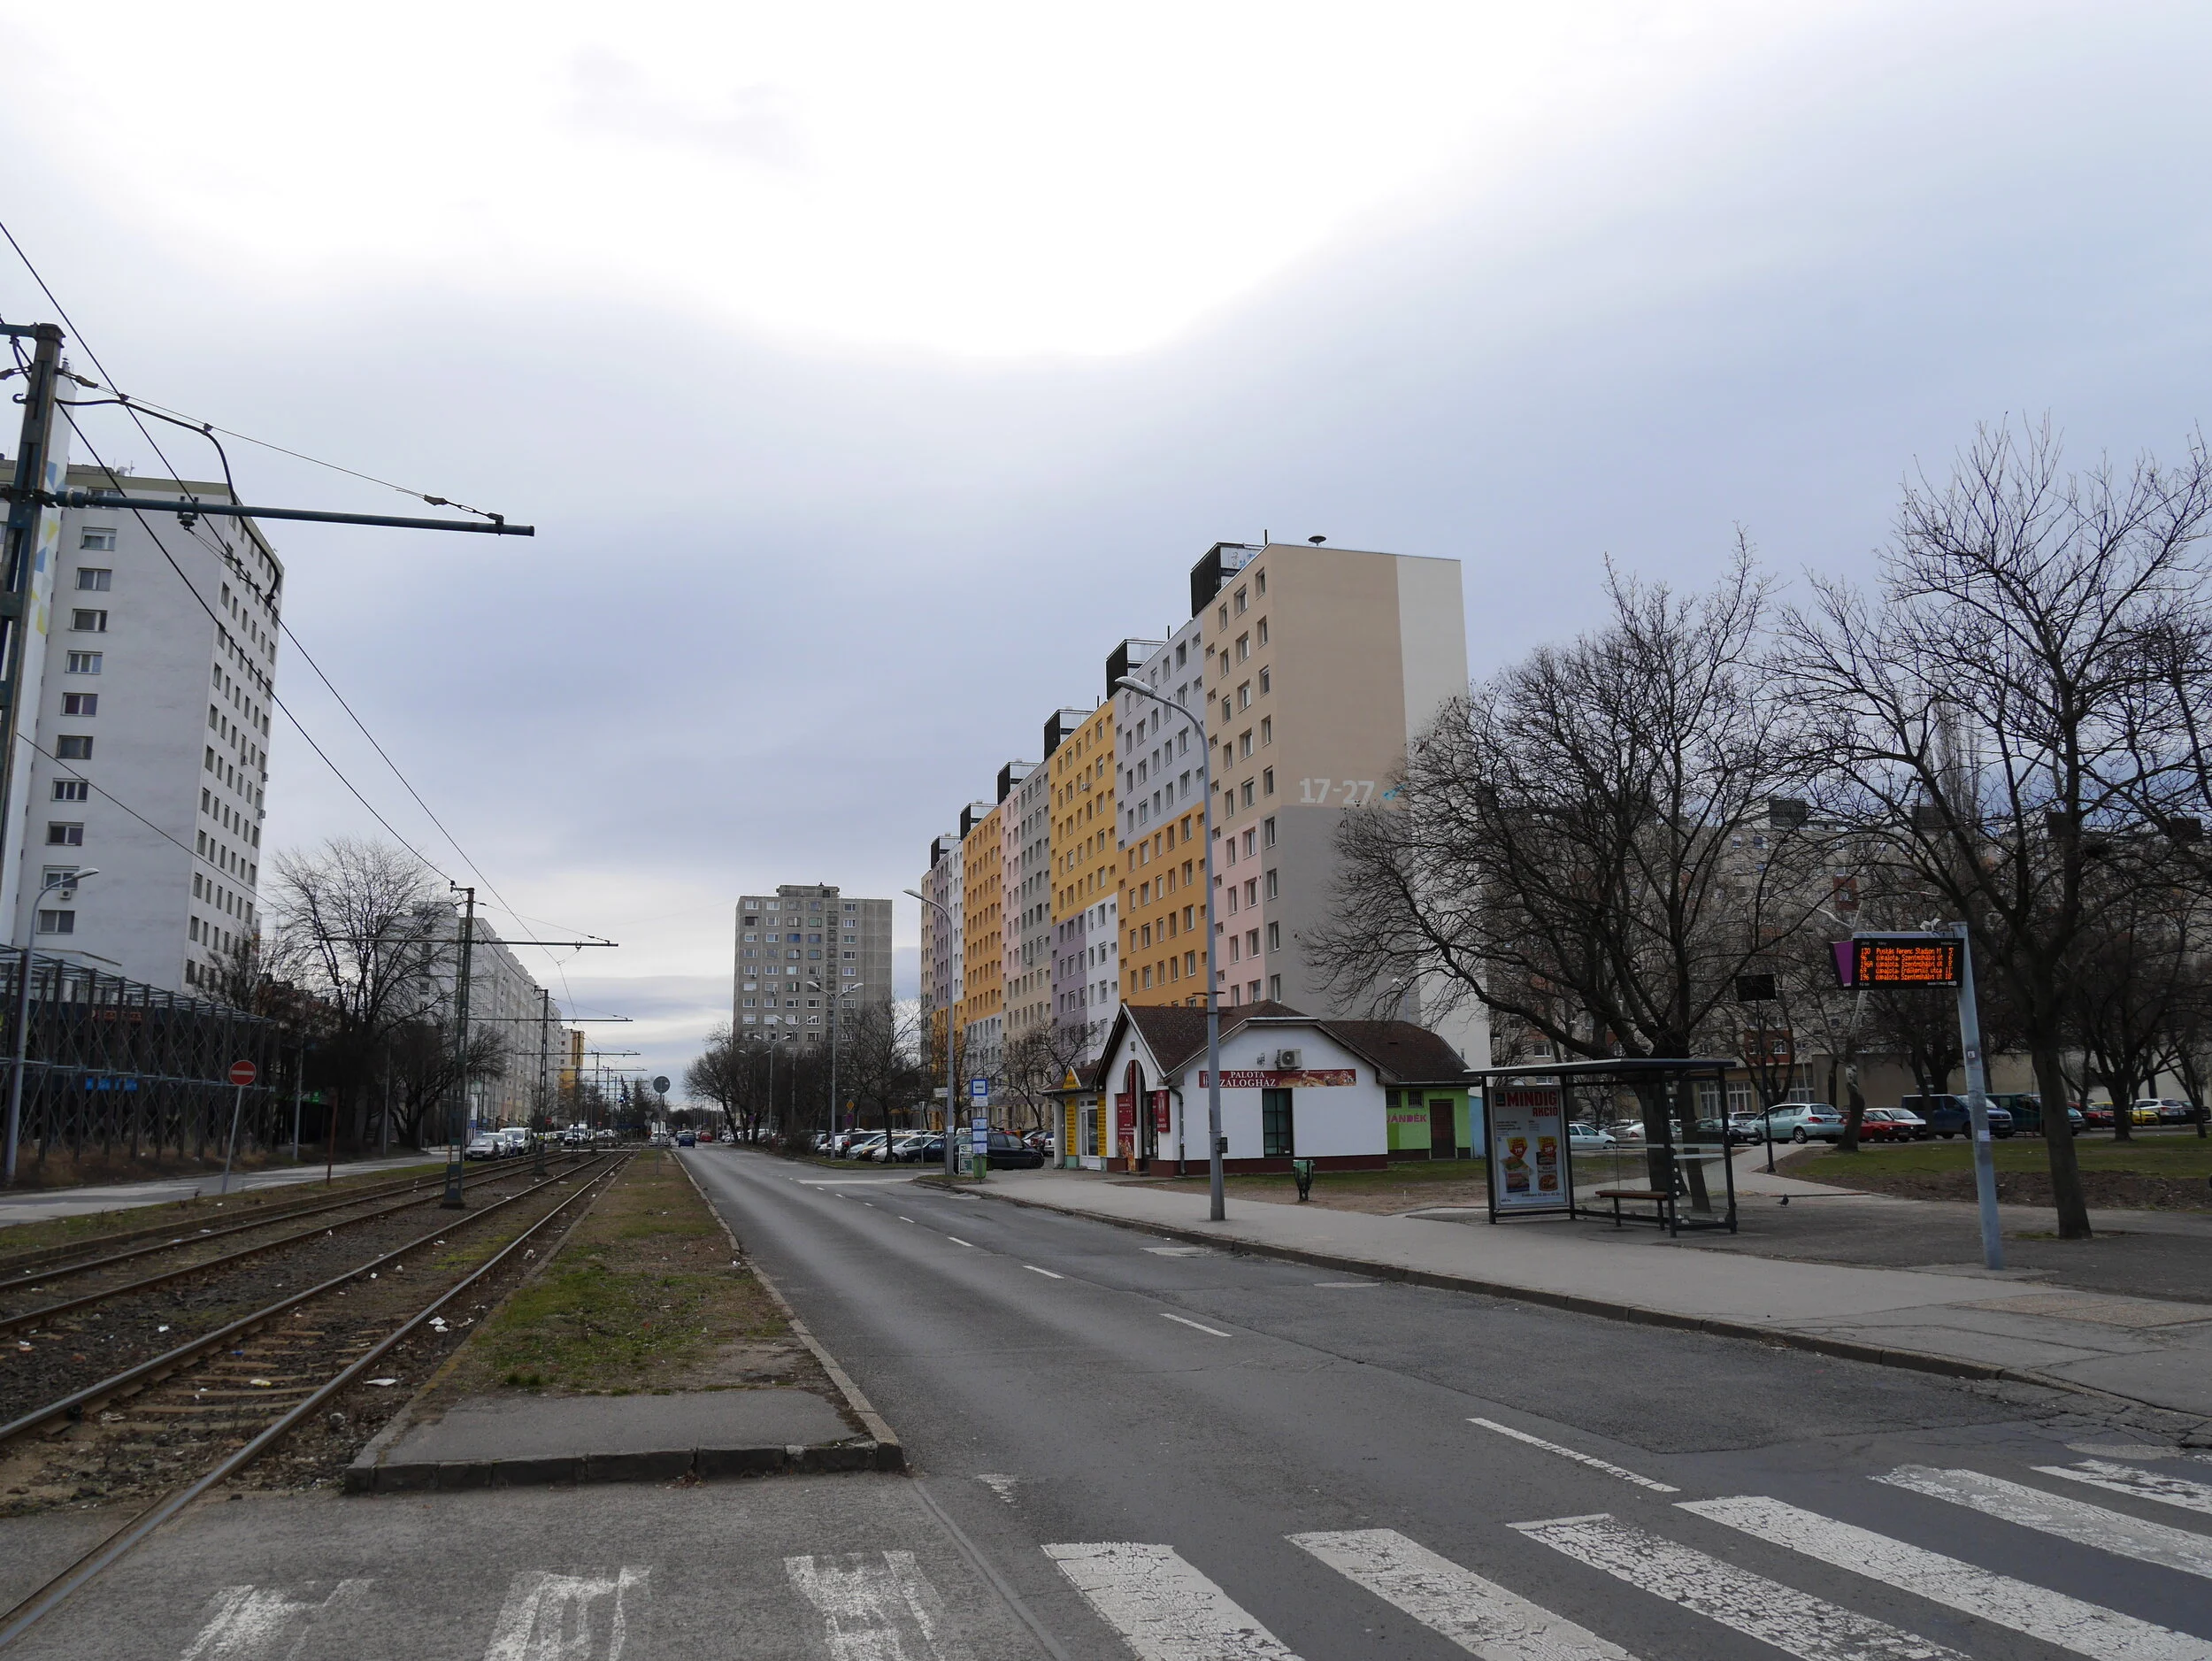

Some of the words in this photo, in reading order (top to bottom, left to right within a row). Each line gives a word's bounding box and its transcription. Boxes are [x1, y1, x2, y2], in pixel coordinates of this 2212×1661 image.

[1299, 778, 1375, 805] 17-27
[1219, 1077, 1276, 1088] ZÁLOGHÁZ
[1506, 1090, 1557, 1107] MINDIG
